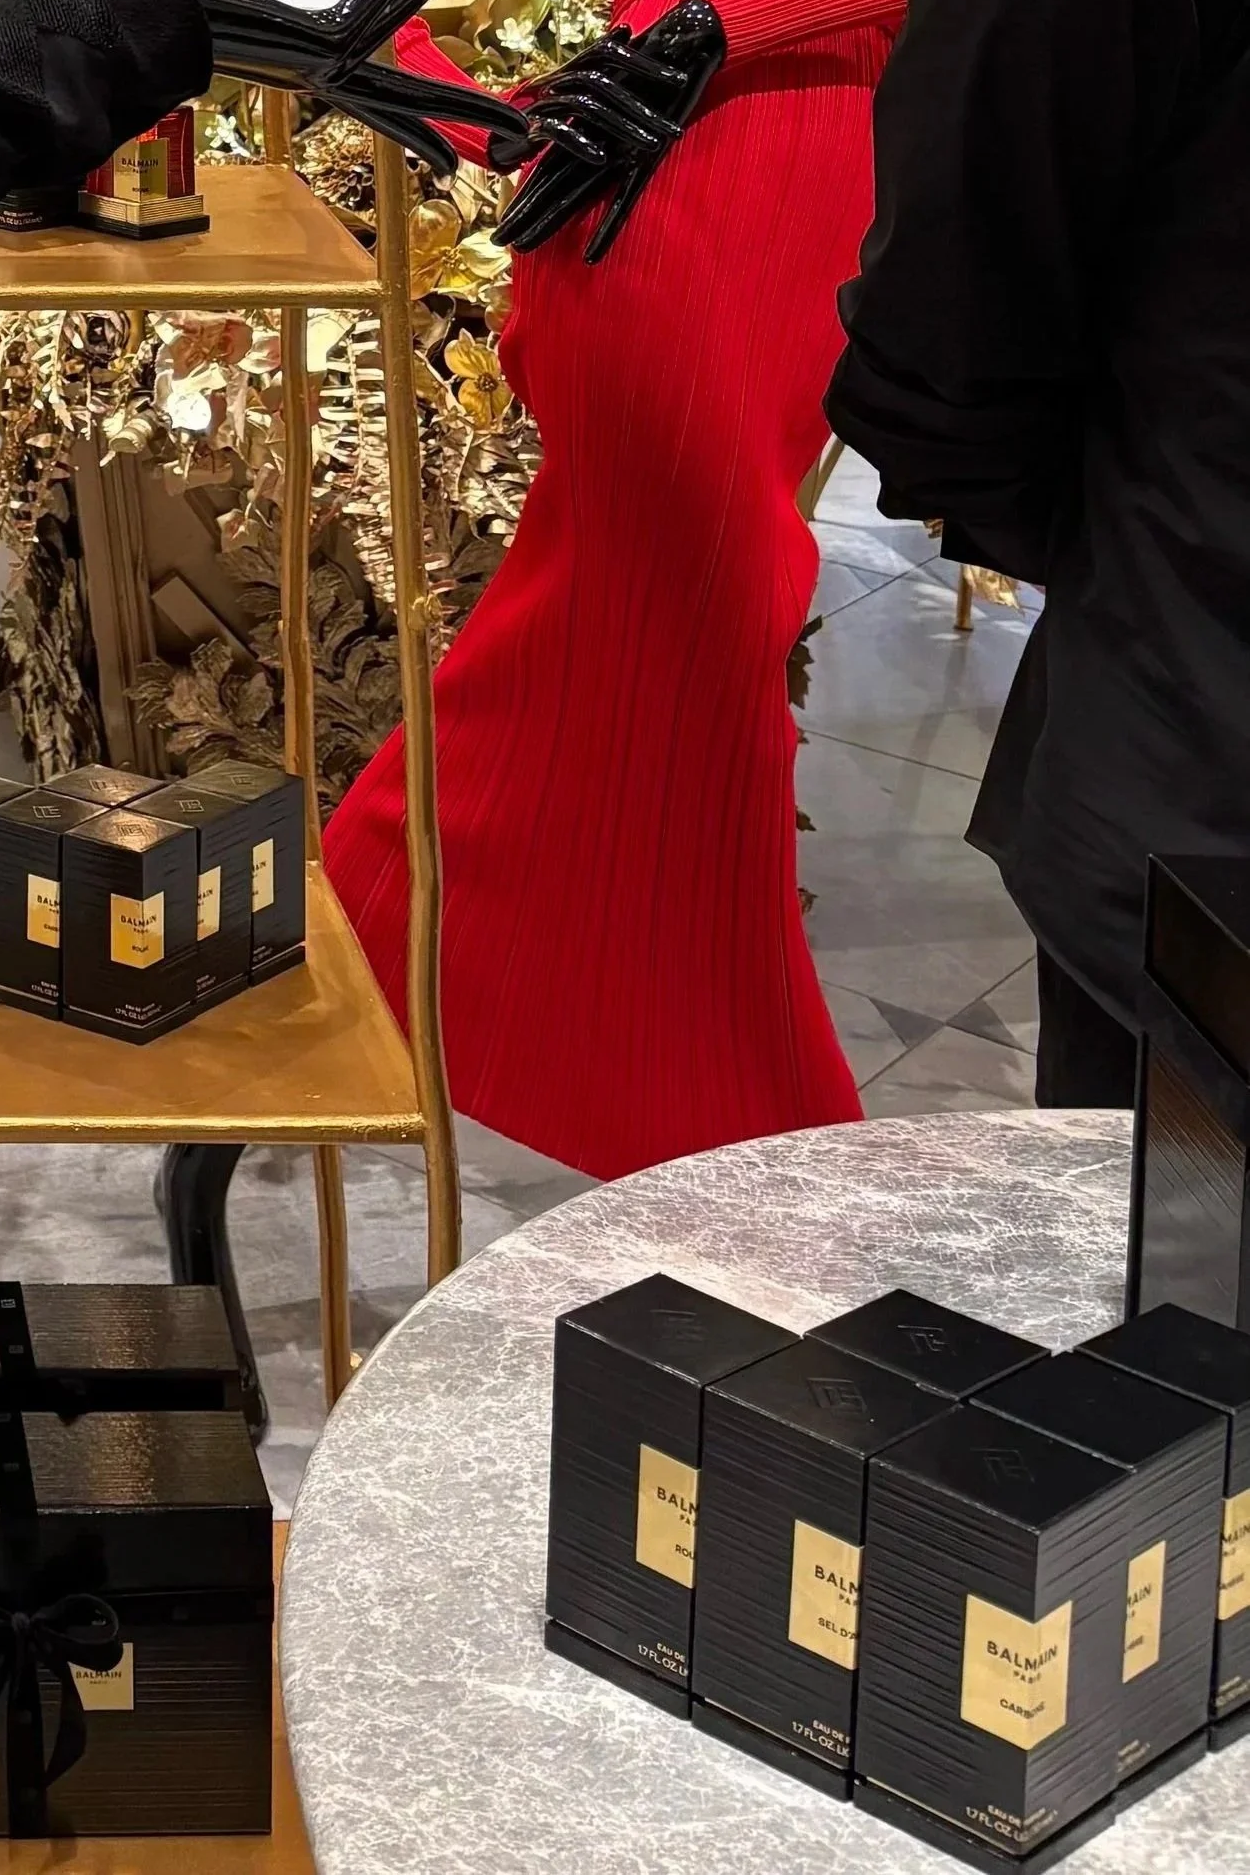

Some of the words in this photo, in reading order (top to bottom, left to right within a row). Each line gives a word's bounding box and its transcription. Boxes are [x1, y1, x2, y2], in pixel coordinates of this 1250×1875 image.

[121, 157, 159, 168] BALMAIN
[120, 914, 157, 927] BALMAIN
[817, 1616, 839, 1634] SEL
[656, 1642, 673, 1656] EAU
[673, 1651, 687, 1663] DE
[986, 1640, 1058, 1671] BALMAIN
[76, 1670, 122, 1679] BALMAIN
[999, 1697, 1046, 1720] CARBONE
[813, 1719, 831, 1735] EAU
[831, 1729, 845, 1742] DE
[988, 1804, 1007, 1820] EAU
